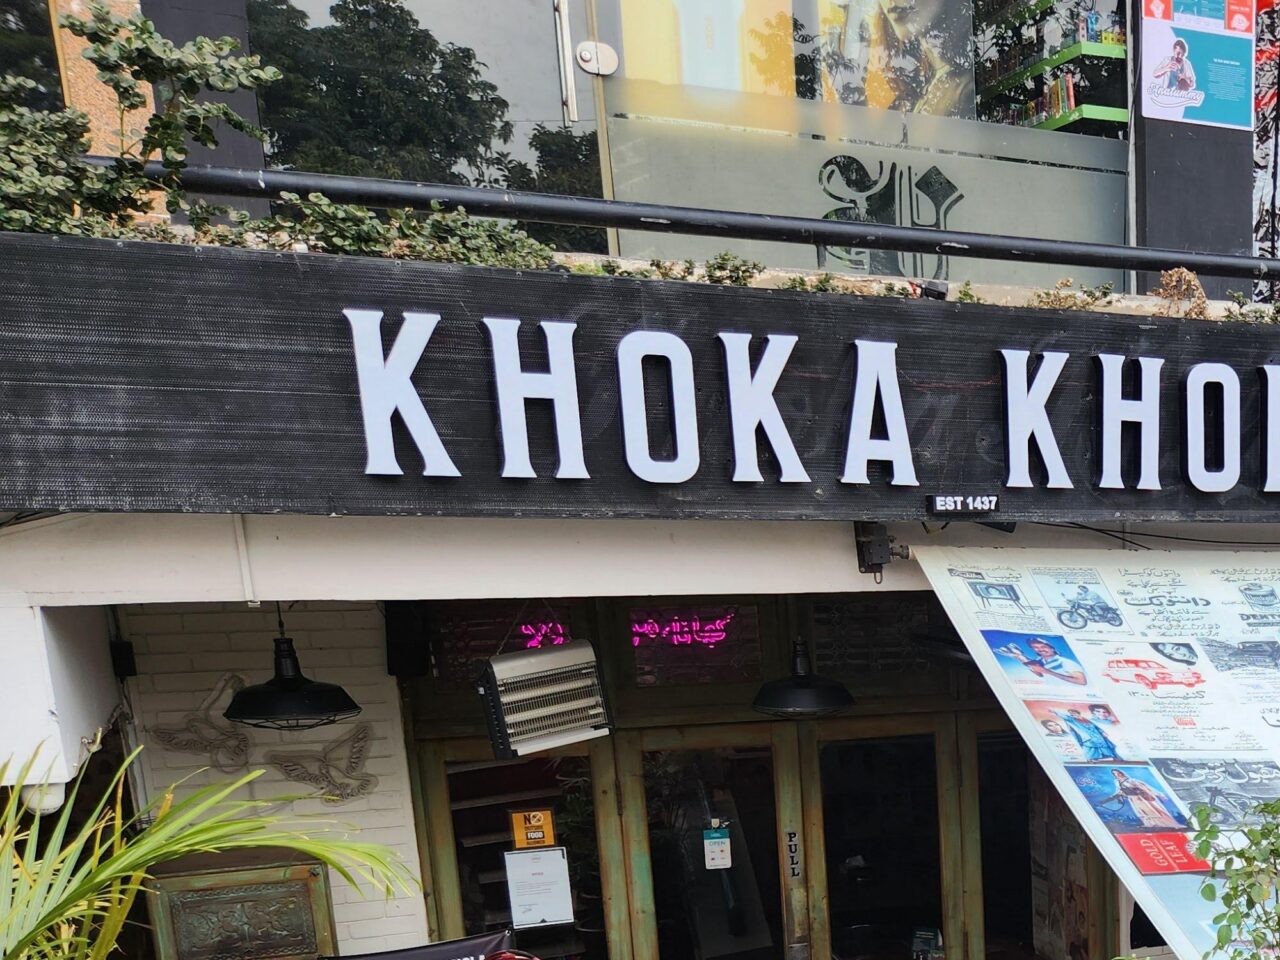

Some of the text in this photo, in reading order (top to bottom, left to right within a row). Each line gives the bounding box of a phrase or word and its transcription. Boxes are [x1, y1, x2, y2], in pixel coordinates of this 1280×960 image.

[341, 307, 921, 487] KHOKA
[935, 495, 998, 511] EST 1437
[787, 832, 800, 877] PULL
[1139, 838, 1169, 867] GOLD
[1160, 839, 1188, 865] LEAF
